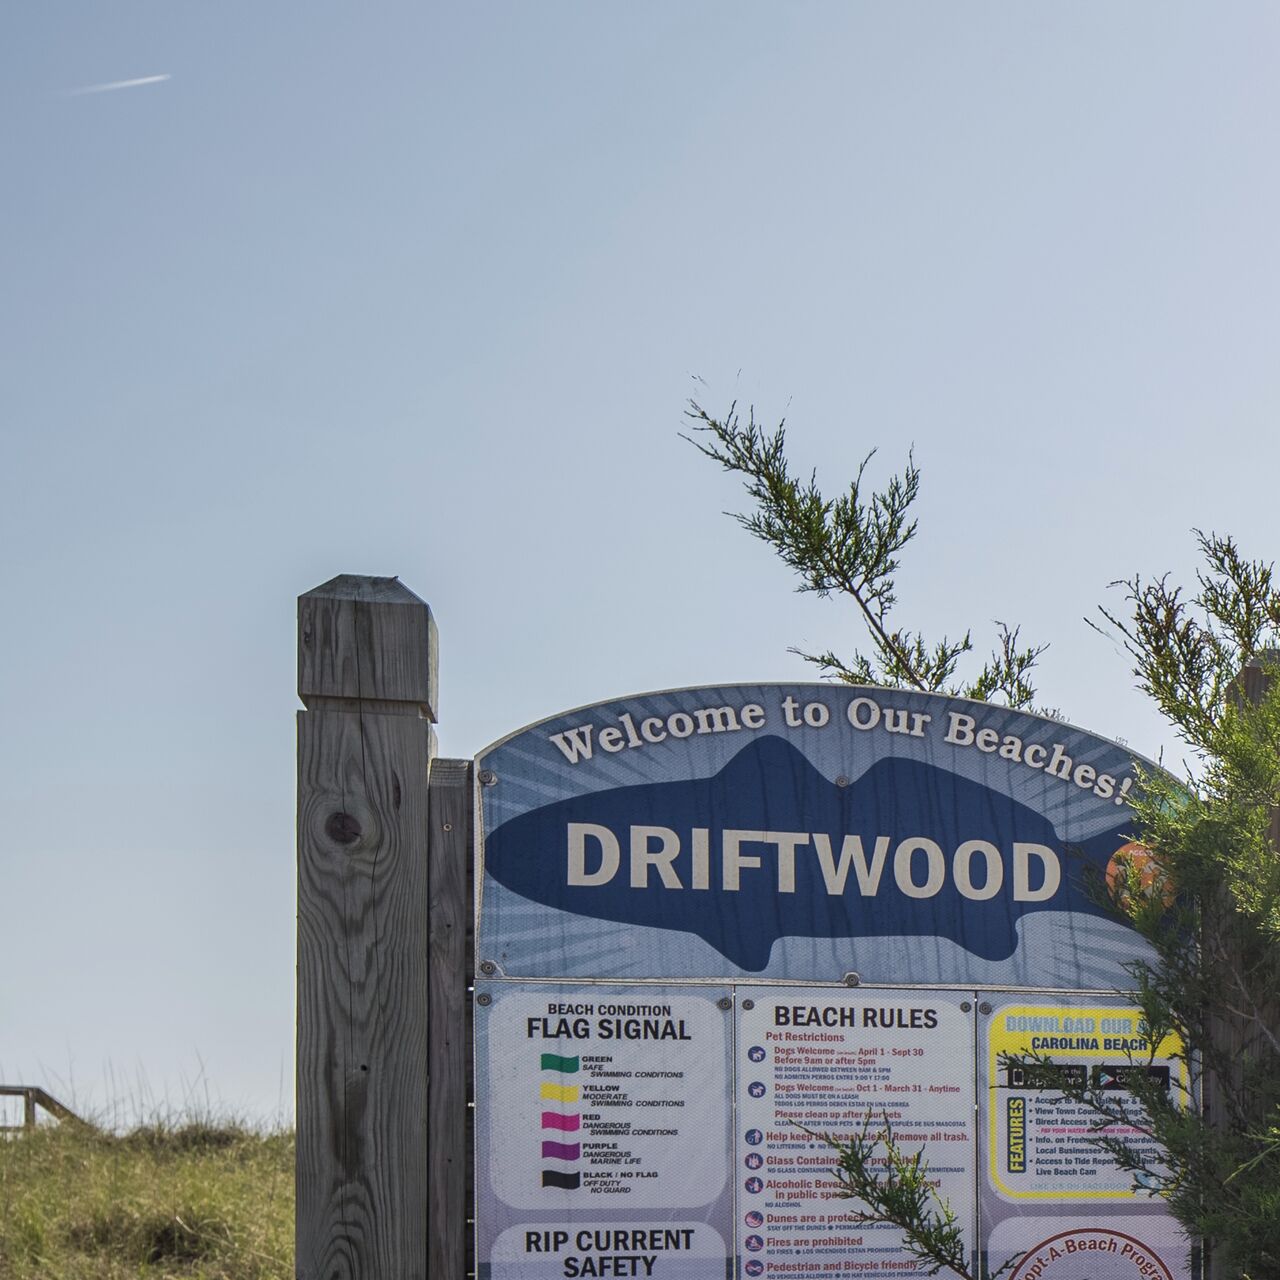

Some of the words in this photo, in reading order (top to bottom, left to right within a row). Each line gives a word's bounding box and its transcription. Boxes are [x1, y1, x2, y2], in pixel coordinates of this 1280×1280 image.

[549, 703, 765, 764] Welcome
[782, 696, 830, 727] to
[847, 697, 931, 736] Our
[944, 711, 1132, 804] Beaches!
[567, 822, 1060, 902] DRIFTWOOD
[548, 1004, 593, 1015] BEACH
[598, 1005, 671, 1016] CONDITION
[775, 1006, 854, 1027] BEACH
[863, 1008, 938, 1028] RULES
[528, 1017, 589, 1039] FLAG
[598, 1018, 691, 1040] SIGNAL
[1006, 1016, 1095, 1033] DOWNLOAD
[1101, 1018, 1131, 1034] OUR
[766, 1032, 783, 1041] Pet
[785, 1032, 845, 1042] Restrictions
[1032, 1037, 1099, 1050] CAROLINA
[1104, 1038, 1147, 1050] BEACH
[774, 1046, 795, 1055] Dogs
[858, 1048, 877, 1056] April
[892, 1048, 911, 1057] Sept
[774, 1056, 802, 1064] Before
[835, 1057, 855, 1065] after
[858, 1058, 876, 1066] 5pm
[774, 1084, 795, 1092] Dogs
[856, 1084, 870, 1092] Oct
[884, 1084, 911, 1092] March
[929, 1085, 960, 1094] Anytime
[766, 1131, 788, 1141] Help
[790, 1131, 812, 1142] keep
[894, 1133, 928, 1141] Remove
[930, 1132, 941, 1140] all
[943, 1132, 969, 1141] trash.
[1009, 1099, 1024, 1170] FEATURES
[766, 1156, 794, 1165] Glass
[766, 1180, 812, 1189] Alcoholic
[787, 1190, 818, 1199] public
[767, 1214, 798, 1223] Dunes
[526, 1231, 569, 1252] RIP
[576, 1229, 695, 1251] CURRENT
[767, 1238, 791, 1247] Fires
[812, 1237, 863, 1248] prohibited
[563, 1255, 657, 1278] SAFETY
[767, 1262, 821, 1271] Pedestrian
[823, 1262, 841, 1270] and
[844, 1261, 879, 1271] Bicycle
[881, 1261, 917, 1271] friendly
